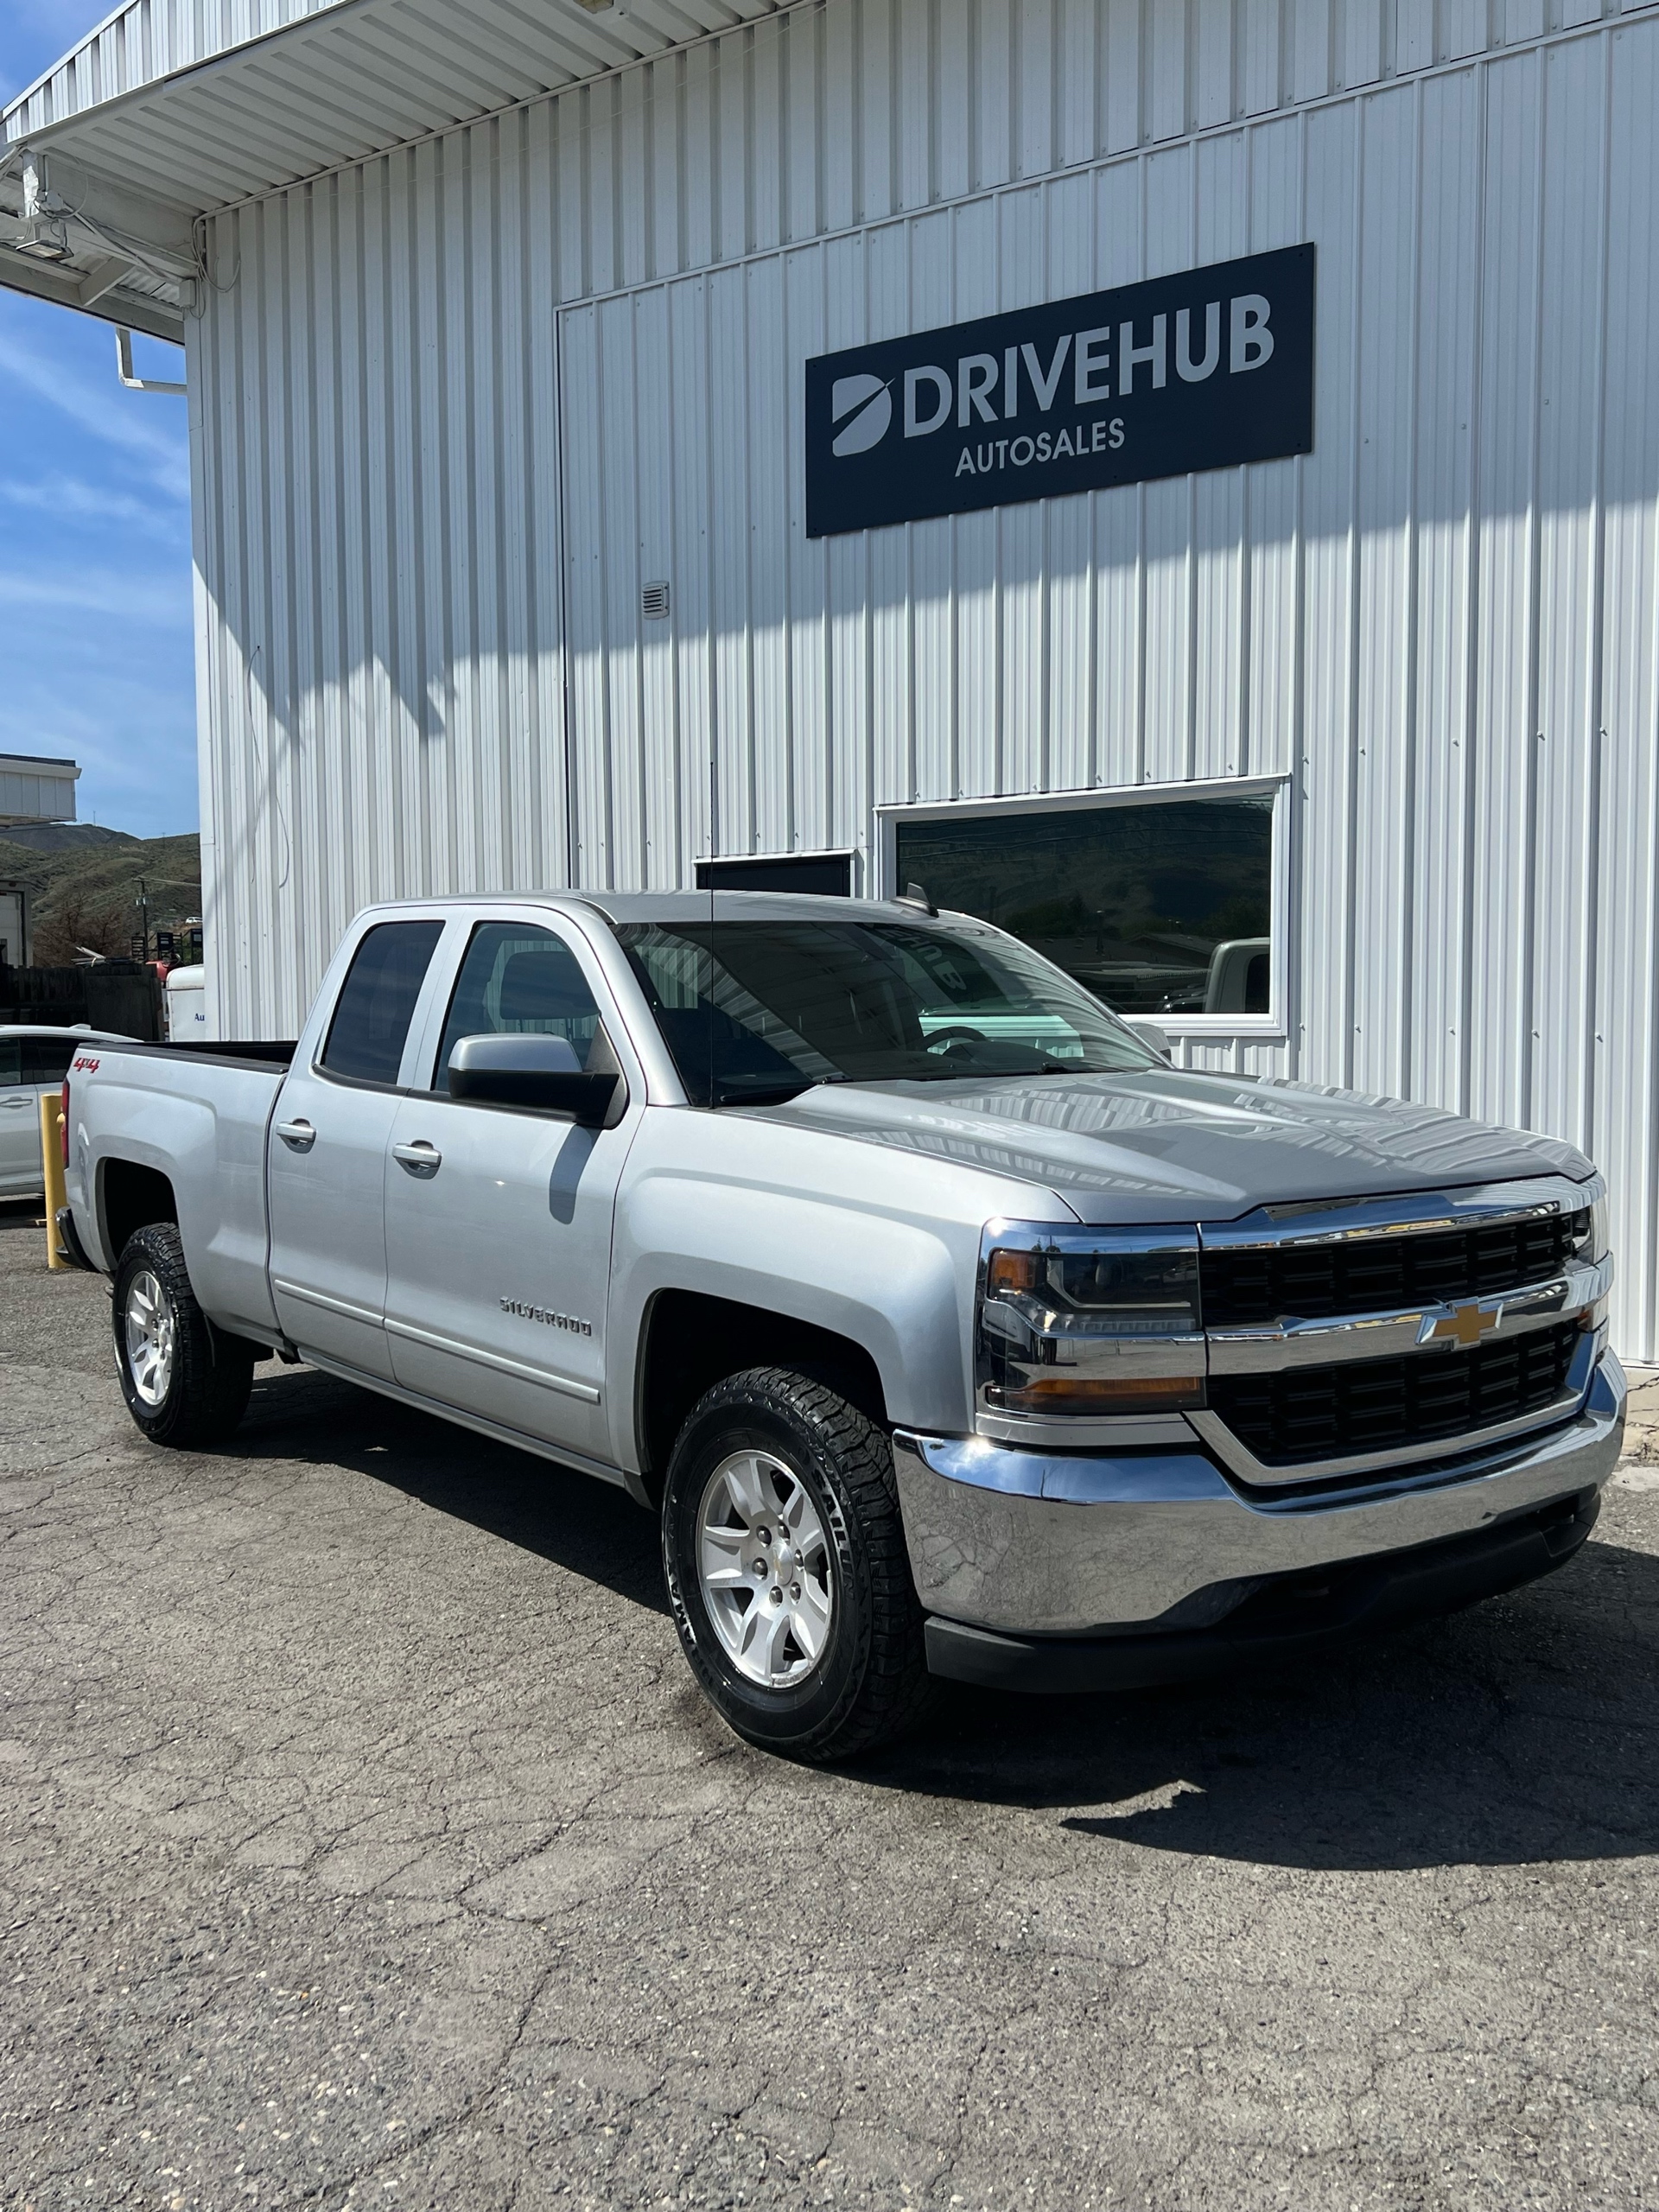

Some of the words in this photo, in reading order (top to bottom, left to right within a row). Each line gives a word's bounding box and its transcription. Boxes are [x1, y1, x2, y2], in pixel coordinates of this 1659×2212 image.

[904, 294, 1274, 438] DRIVEHUB
[955, 418, 1125, 477] AUTOSALES
[499, 1295, 592, 1337] SILVERADO
